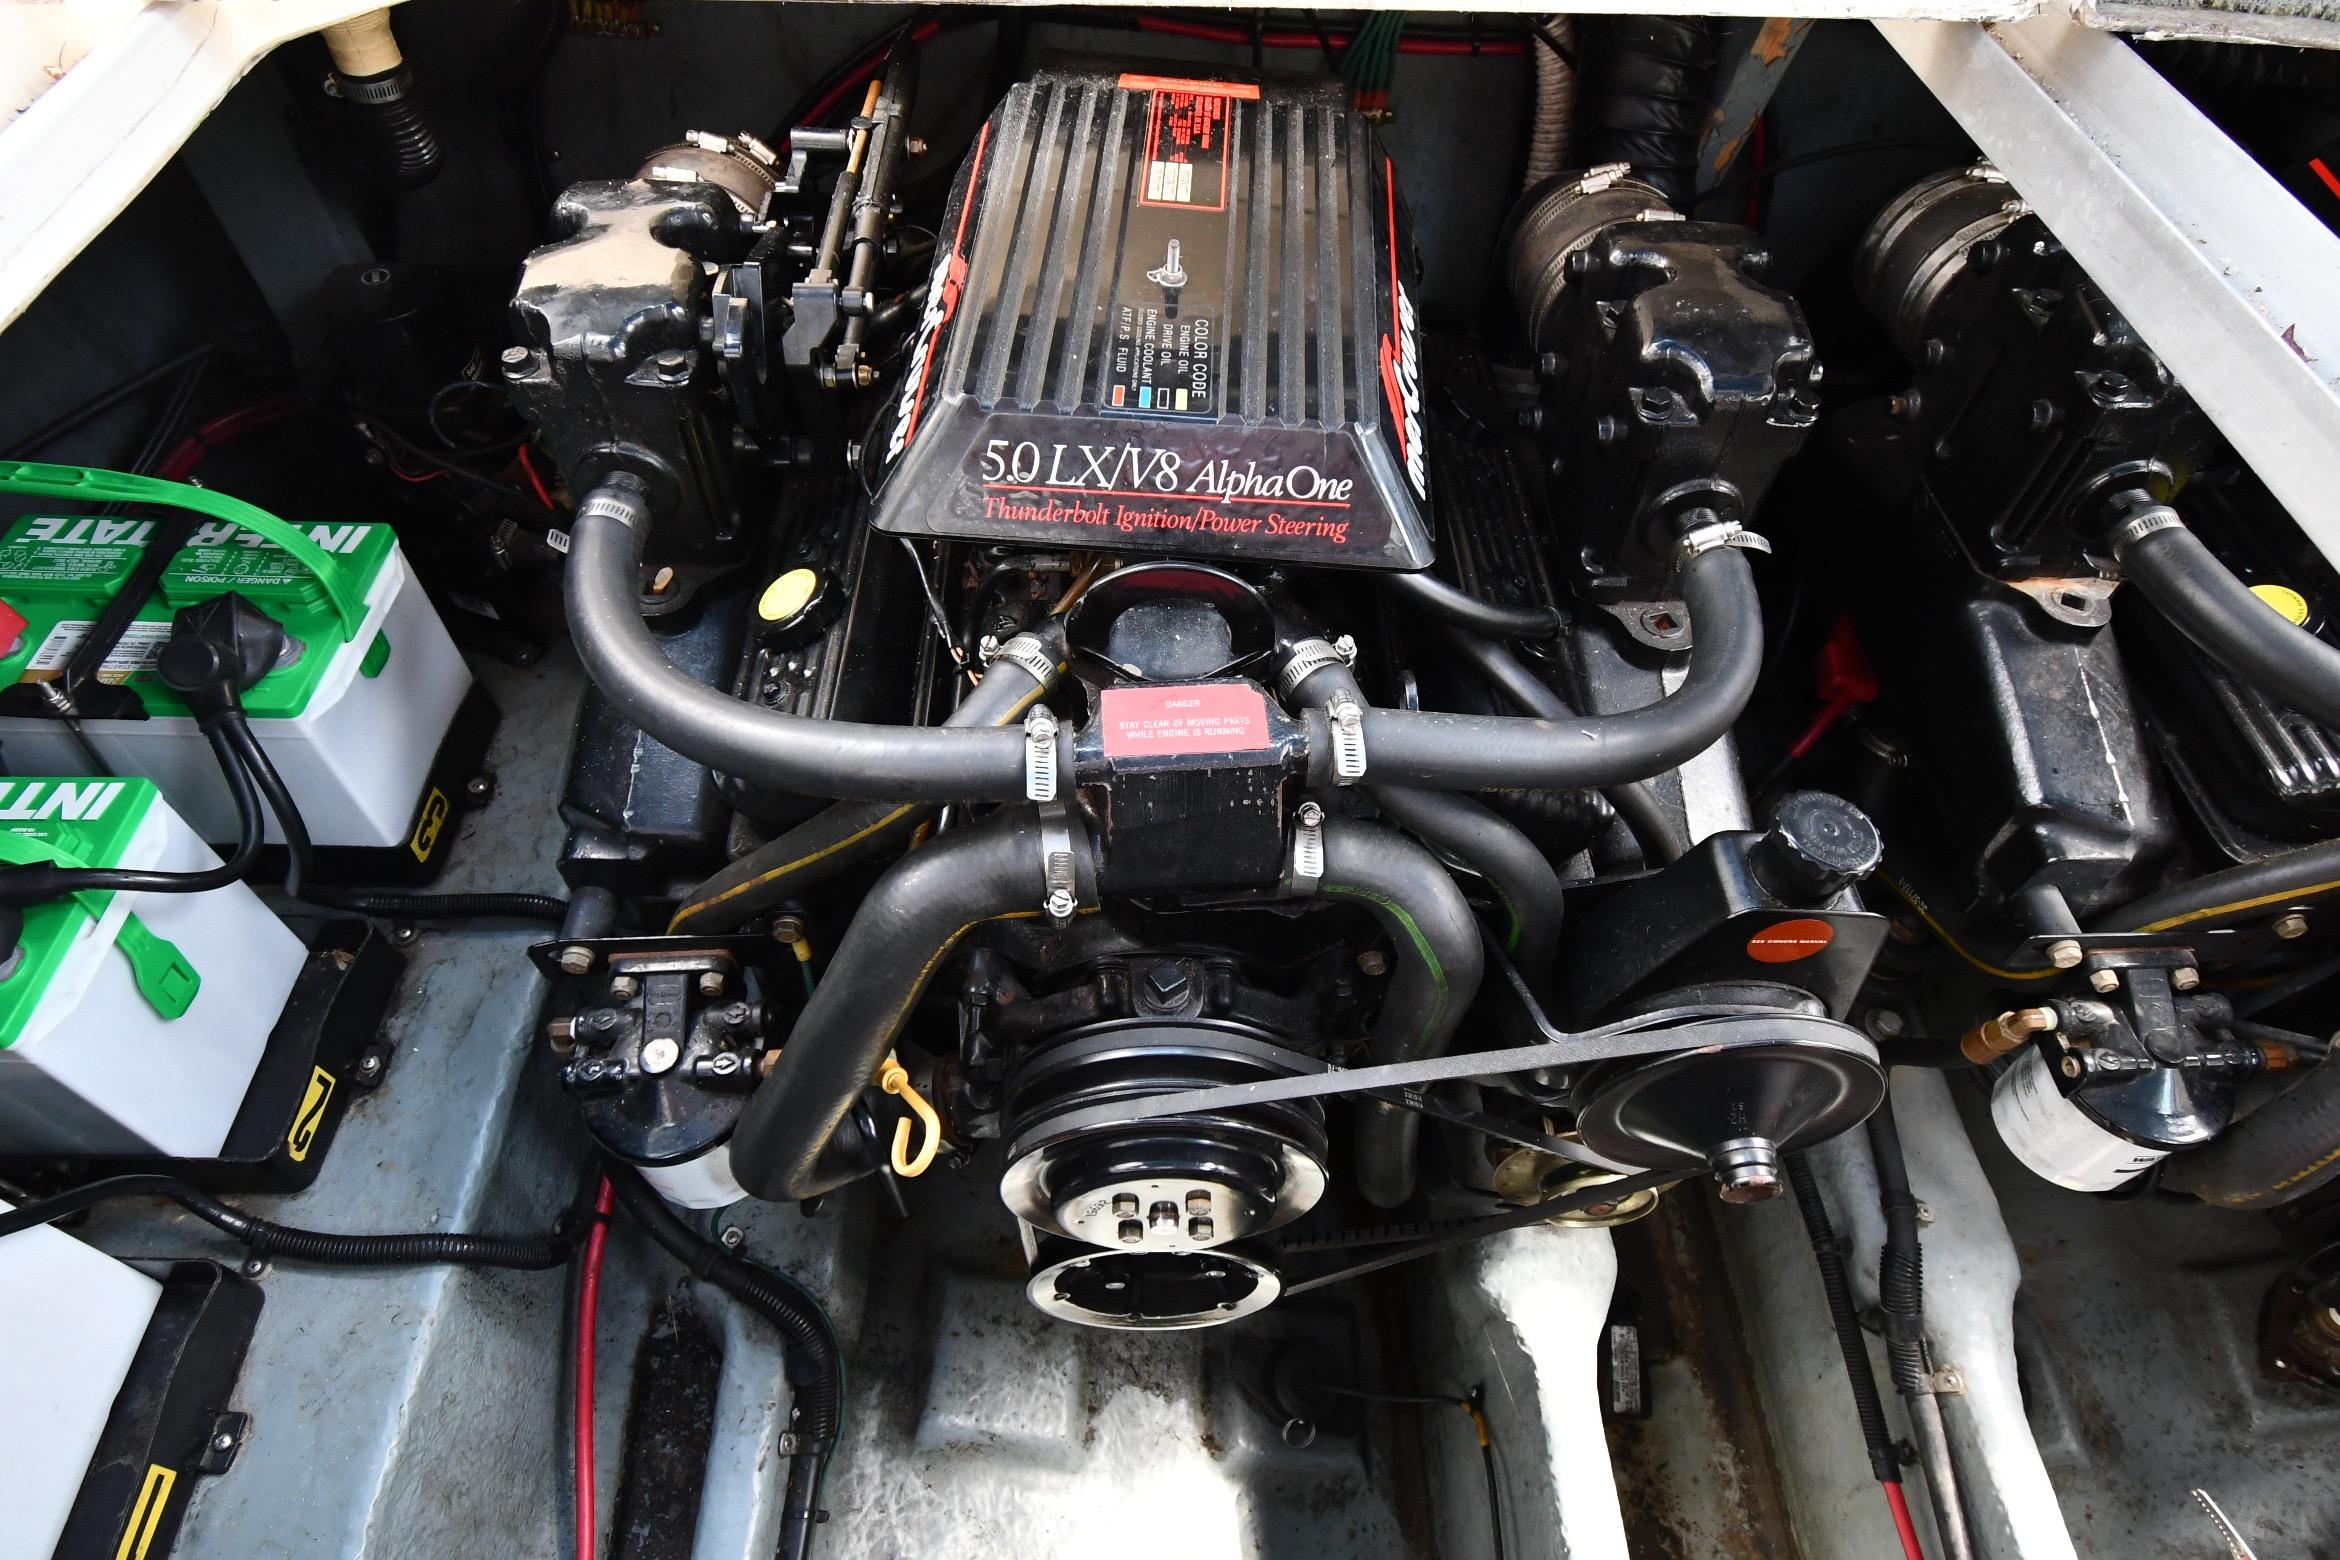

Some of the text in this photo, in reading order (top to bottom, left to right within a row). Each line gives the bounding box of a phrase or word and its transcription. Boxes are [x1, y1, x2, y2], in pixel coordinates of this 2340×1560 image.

[1115, 347, 1129, 373] FLUID
[1141, 308, 1158, 385] ENGINE COOLANT
[1160, 324, 1174, 366] DRIVE OIL
[1177, 325, 1191, 375] ENGINE OIL
[1191, 319, 1209, 398] COLOR CODE
[982, 439, 1041, 484] 5.0
[1045, 442, 1181, 492] LX/V8
[984, 496, 1350, 544] Thunderbolt Ignition/Power Steering
[185, 574, 226, 583] POISON
[237, 576, 281, 586] DANGER
[1165, 699, 1201, 709] DANGER
[1119, 716, 1250, 730] STAY CLEAR OF MOVING PARTS
[1126, 726, 1245, 739] WHILE ENGINE IS RUNNING
